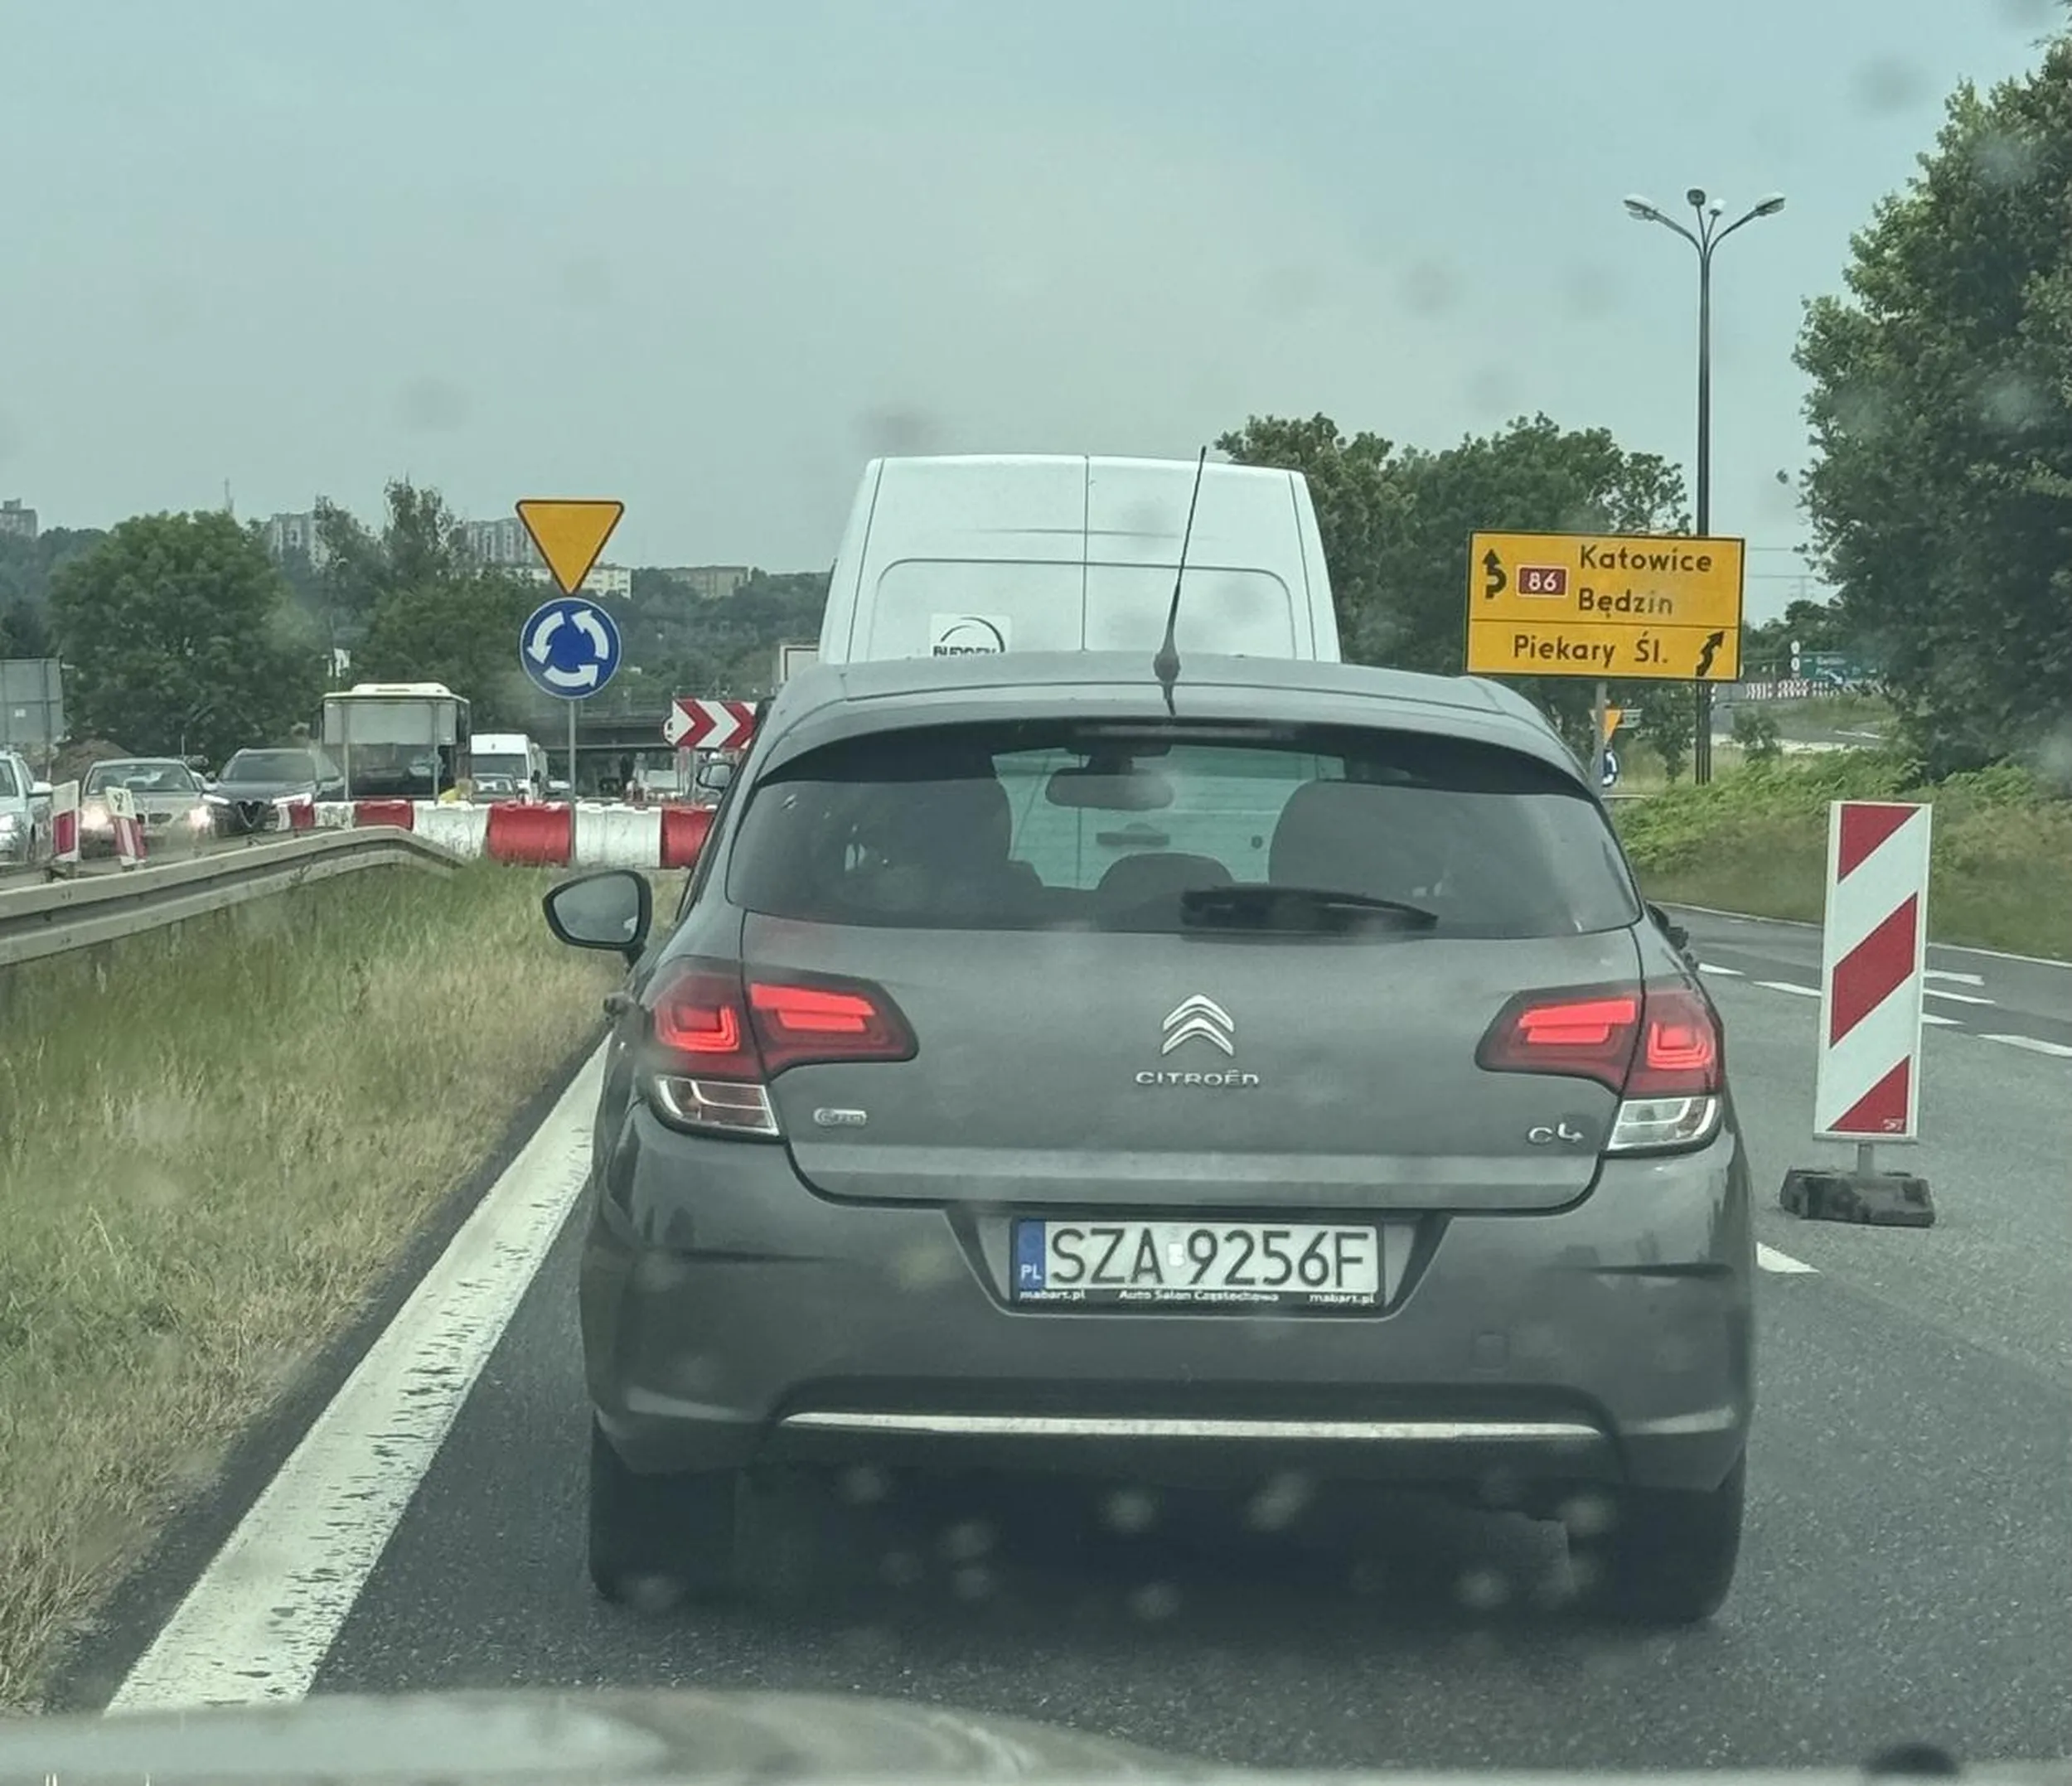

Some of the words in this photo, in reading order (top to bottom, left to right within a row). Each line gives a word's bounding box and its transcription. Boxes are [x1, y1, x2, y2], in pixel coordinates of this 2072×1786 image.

[1581, 545, 1712, 573] Katowice
[1527, 573, 1557, 592] 86
[1579, 588, 1673, 617] Będzin
[1513, 634, 1615, 669] Piekary
[1634, 632, 1668, 664] Śl.
[1528, 1122, 1584, 1143] C4
[1052, 1227, 1164, 1285] SZA
[1187, 1229, 1369, 1288] 9256F
[1021, 1264, 1042, 1280] PL
